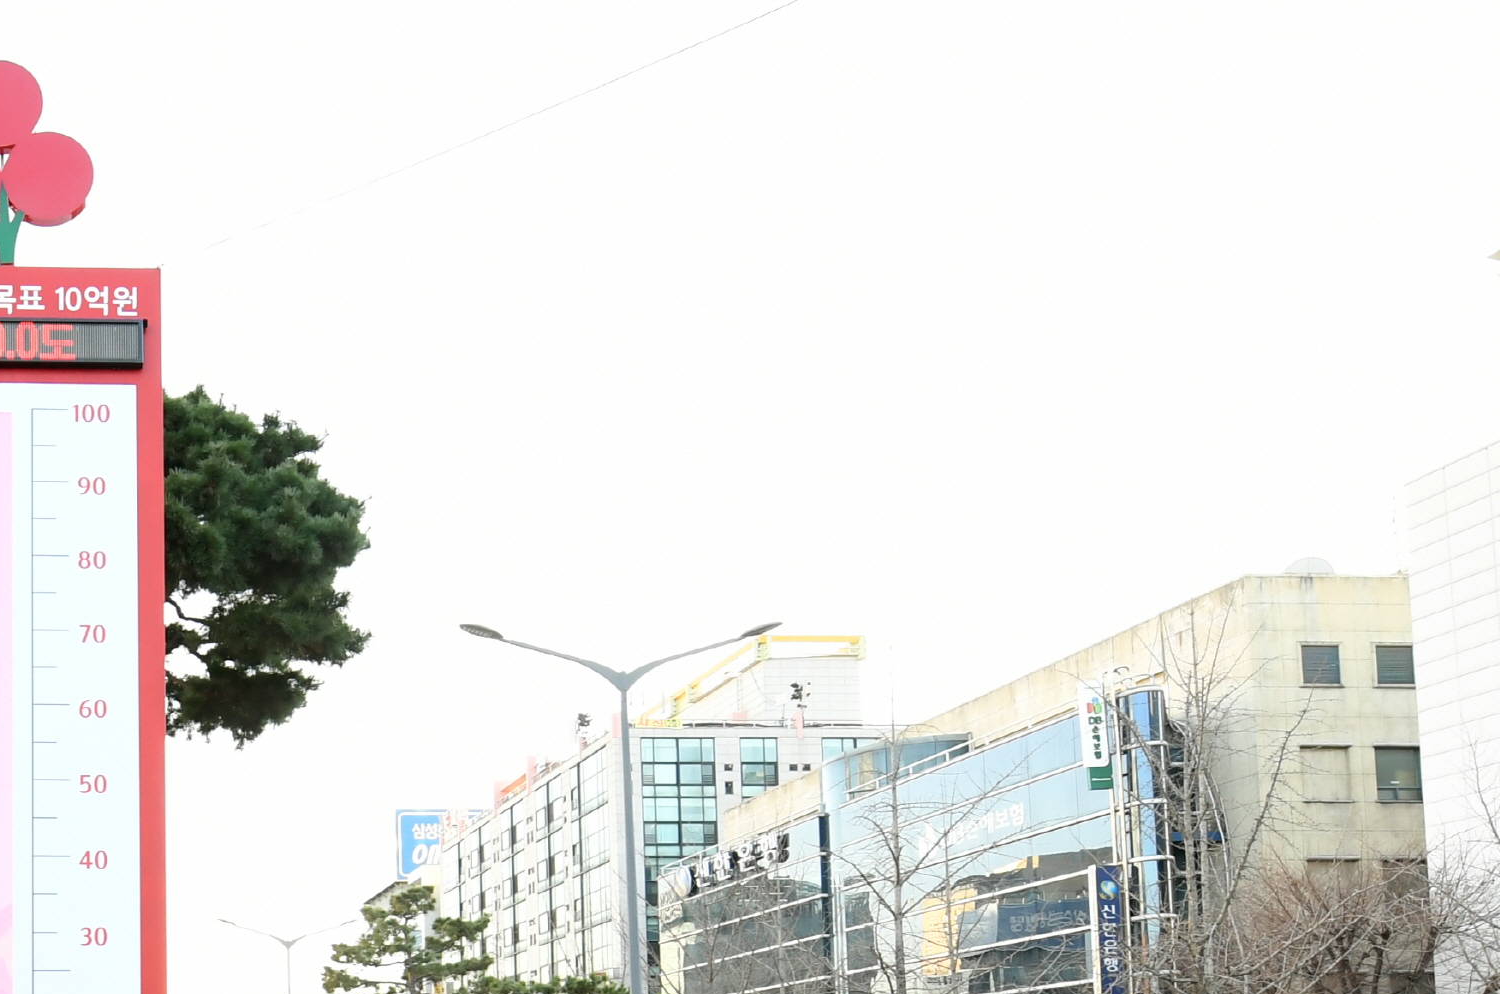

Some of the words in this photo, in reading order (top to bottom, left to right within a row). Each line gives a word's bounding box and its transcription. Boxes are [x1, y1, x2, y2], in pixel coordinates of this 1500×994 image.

[54, 285, 139, 317] 10억원
[72, 404, 111, 423] 100
[77, 477, 107, 496] 90
[77, 551, 108, 570] 80
[78, 625, 107, 644] 70
[78, 699, 108, 719] 60
[78, 774, 108, 794] 50
[78, 850, 109, 870] 40
[79, 927, 109, 947] 30
